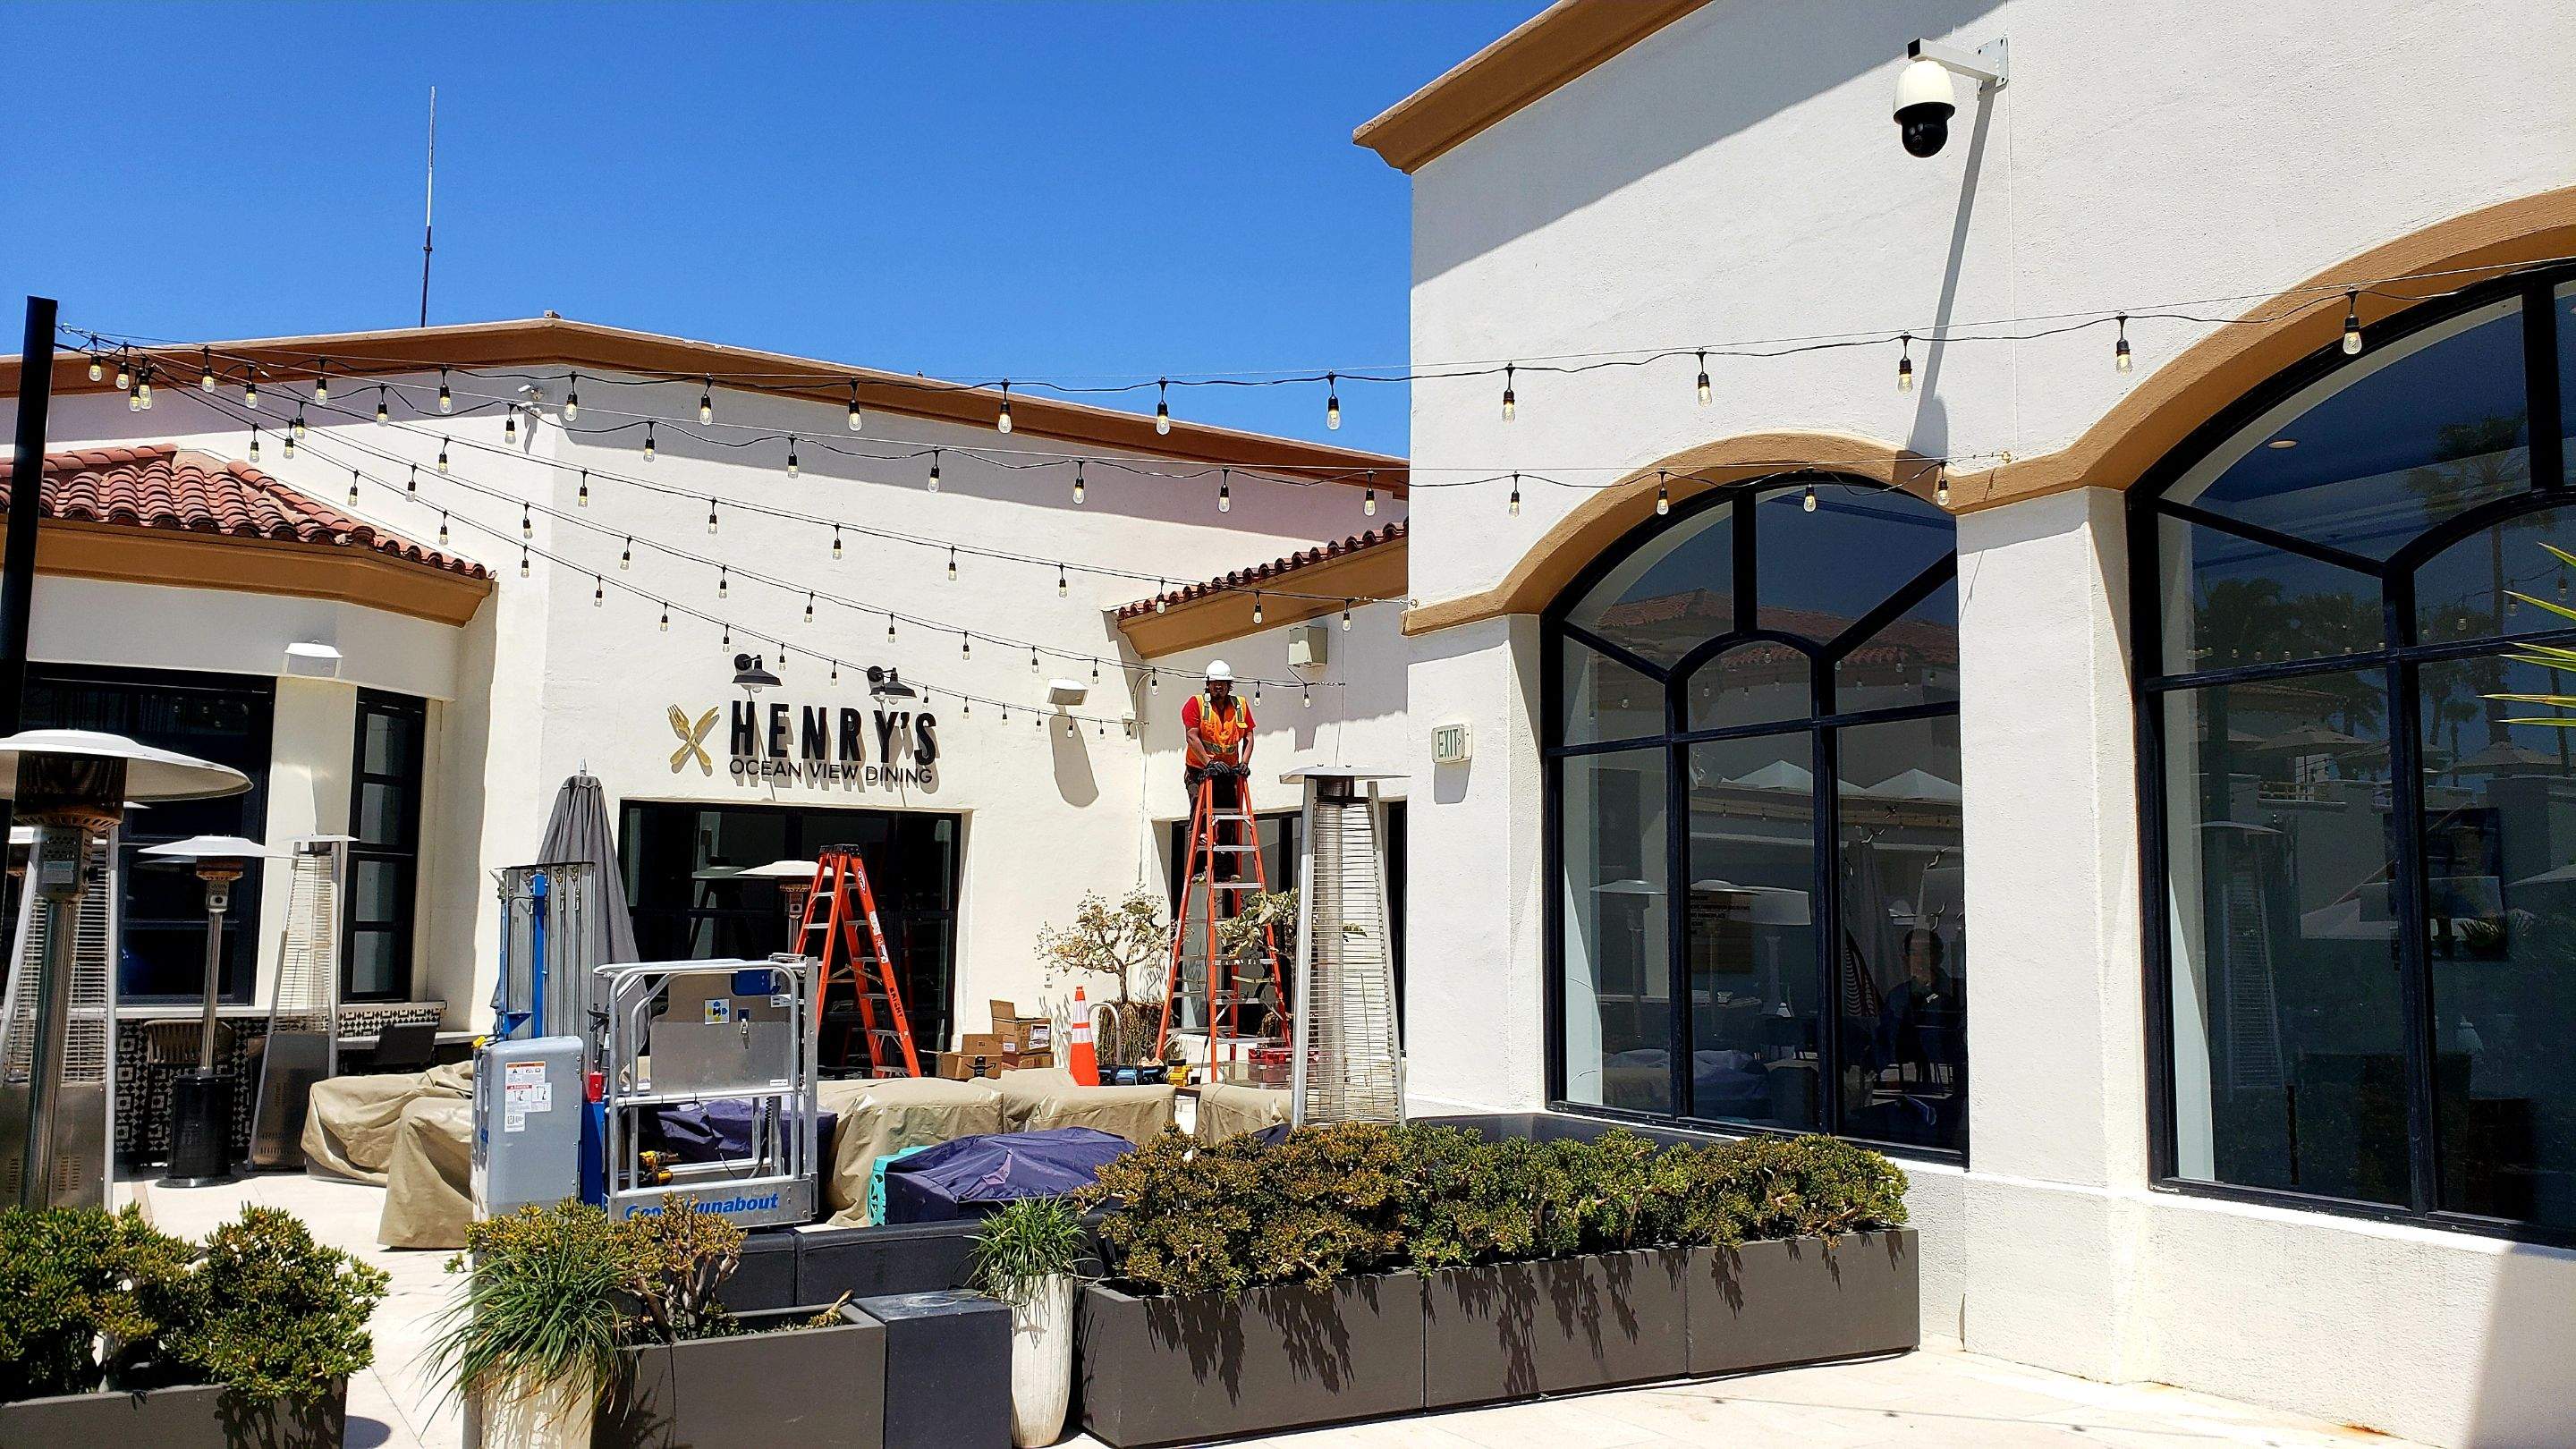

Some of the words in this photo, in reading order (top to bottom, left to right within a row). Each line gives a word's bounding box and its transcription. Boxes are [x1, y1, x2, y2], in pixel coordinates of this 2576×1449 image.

[730, 700, 936, 766] HENRY'S
[1436, 728, 1459, 758] EXIT
[729, 759, 801, 777] OCEAN
[809, 763, 859, 780] VIEW
[865, 766, 933, 784] DINING
